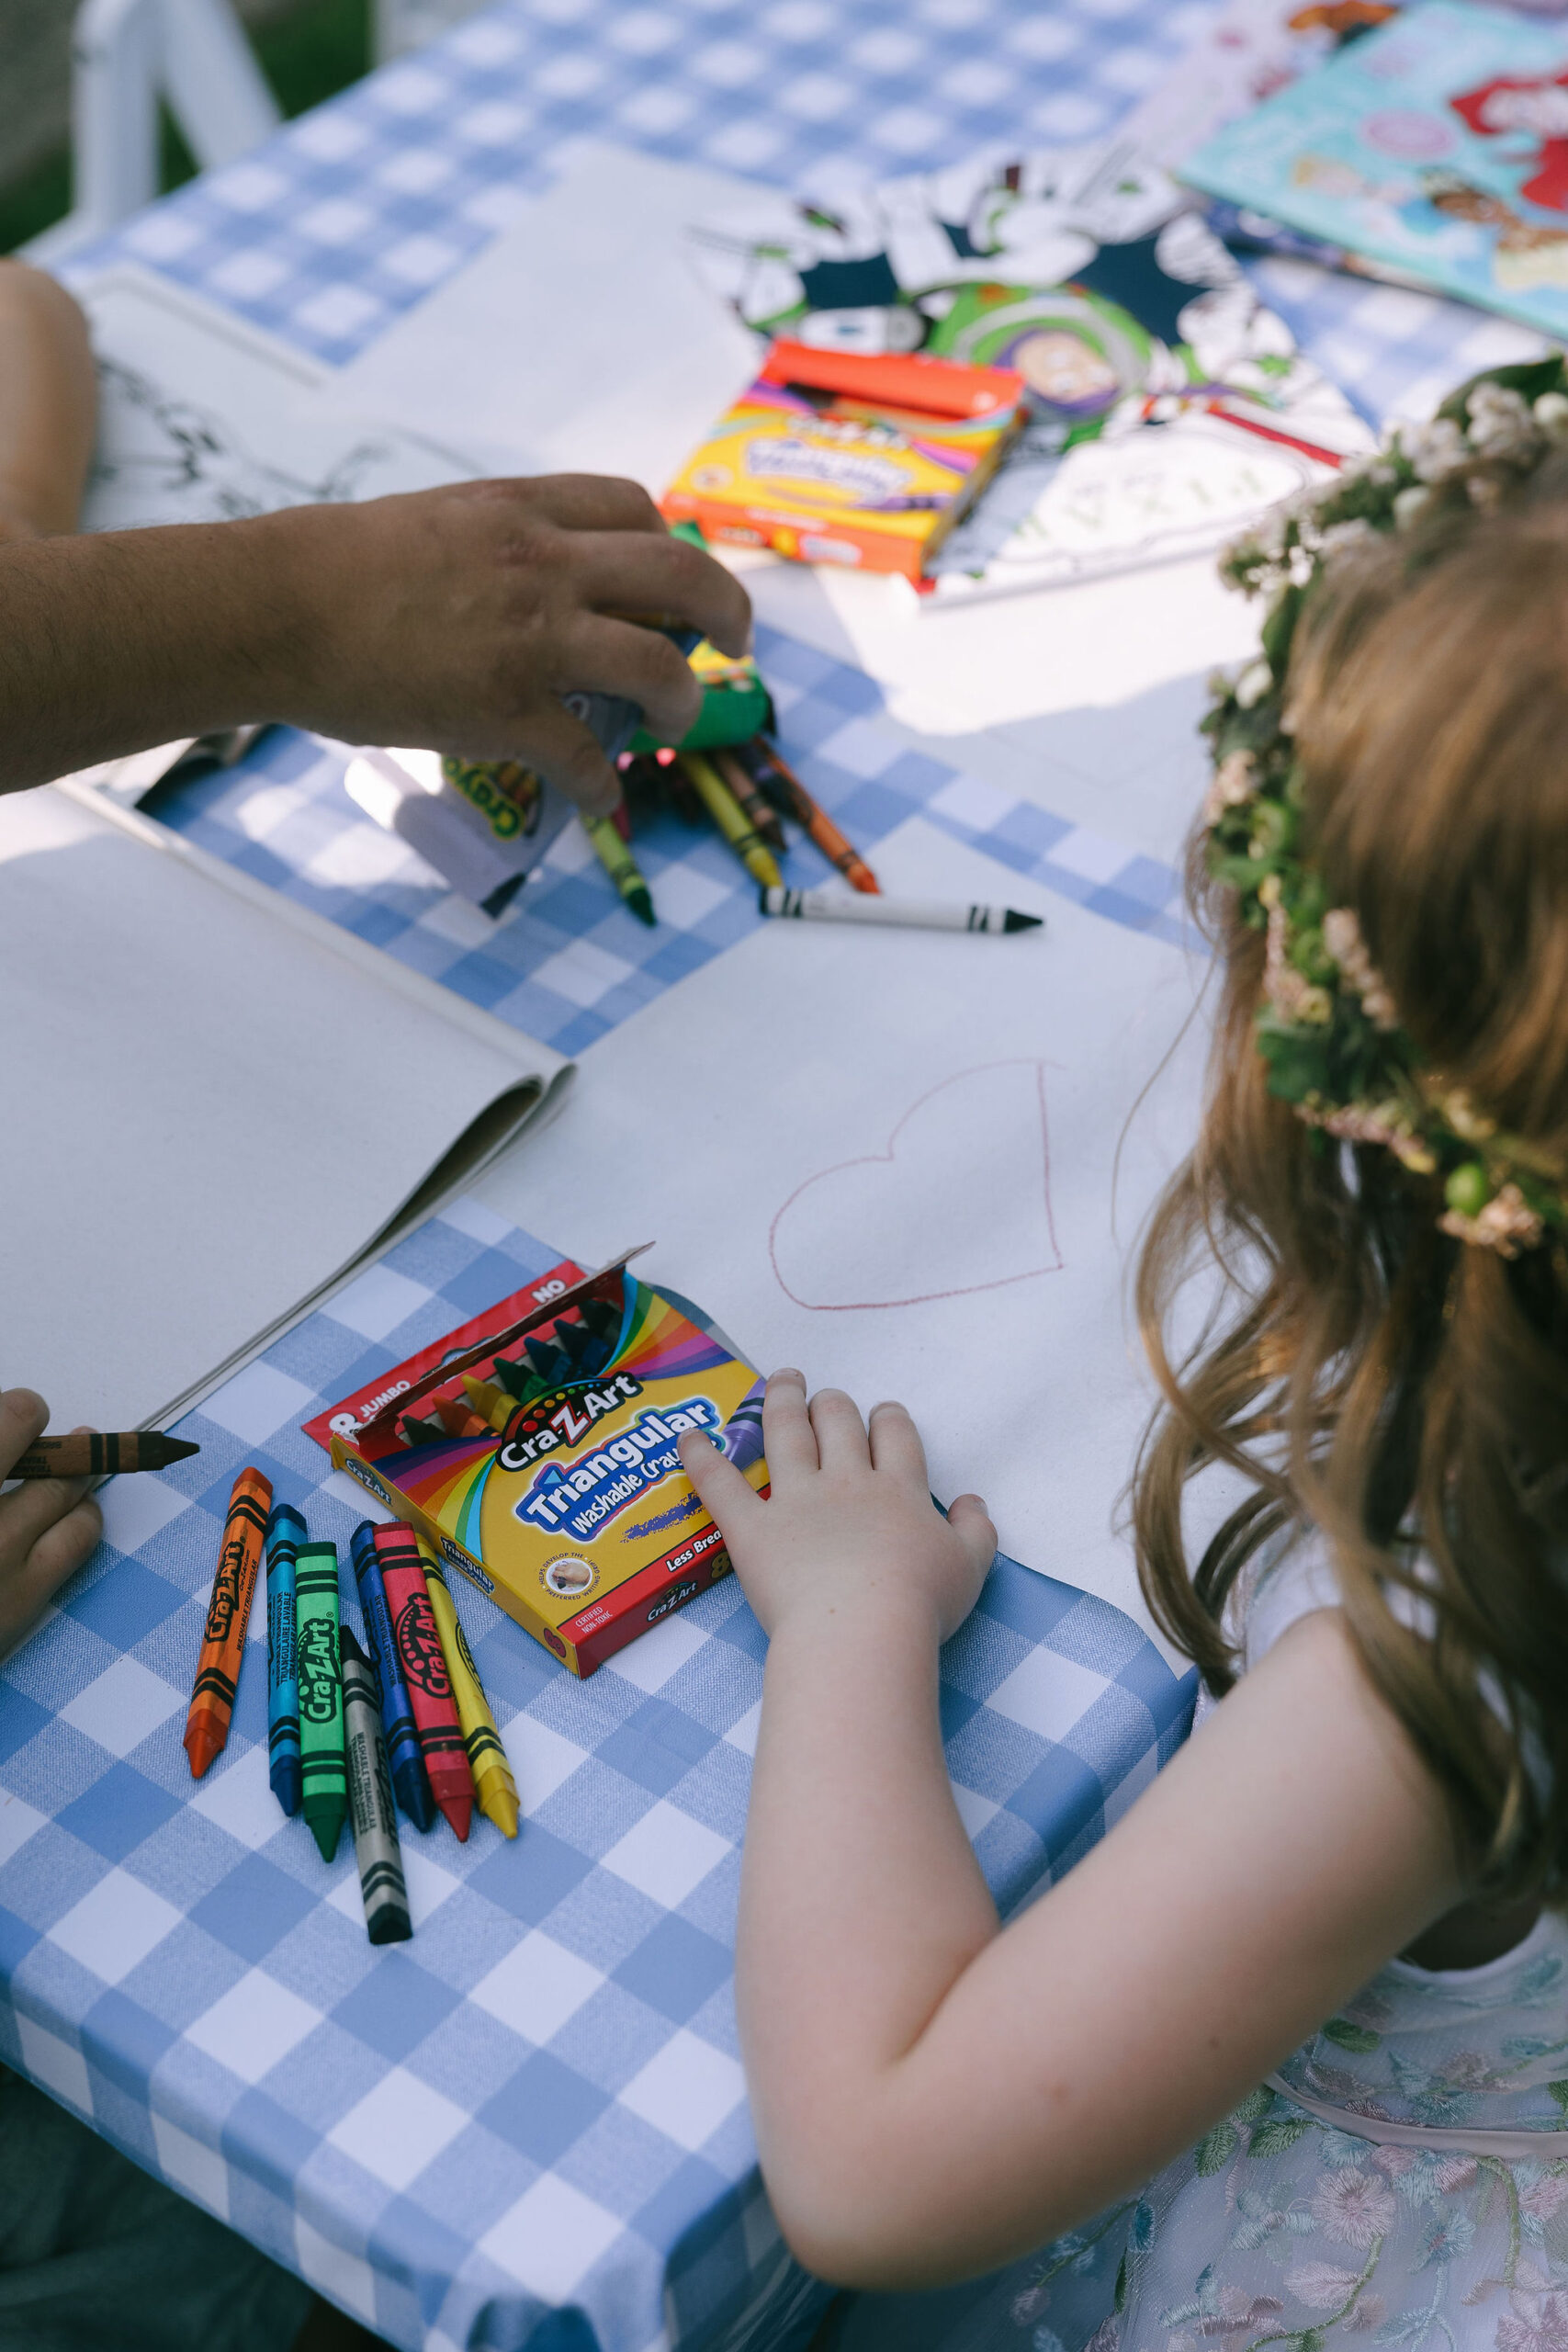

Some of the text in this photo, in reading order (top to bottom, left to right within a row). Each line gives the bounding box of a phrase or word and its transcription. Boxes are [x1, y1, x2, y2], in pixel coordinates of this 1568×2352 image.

[360, 1380, 411, 1419] JUMBO
[501, 1374, 637, 1470] Cra-Z-Art
[526, 1403, 712, 1525] Triangular
[571, 1473, 643, 1534] Washable
[442, 1540, 494, 1589] Triangular
[543, 1553, 569, 1568] DEVELOP
[666, 1530, 723, 1572] Less Brea
[236, 1559, 258, 1653] WASHABLE TRIANGULAR
[546, 1589, 581, 1600] PREFERRED
[582, 1576, 601, 1597] WRITING
[281, 1592, 291, 1683] TRIANGULAIRE LAVABLE
[374, 1594, 390, 1644] TRIANGULAR
[575, 1606, 604, 1627] CERTIFIED
[581, 1610, 614, 1634] NON-TOXIC
